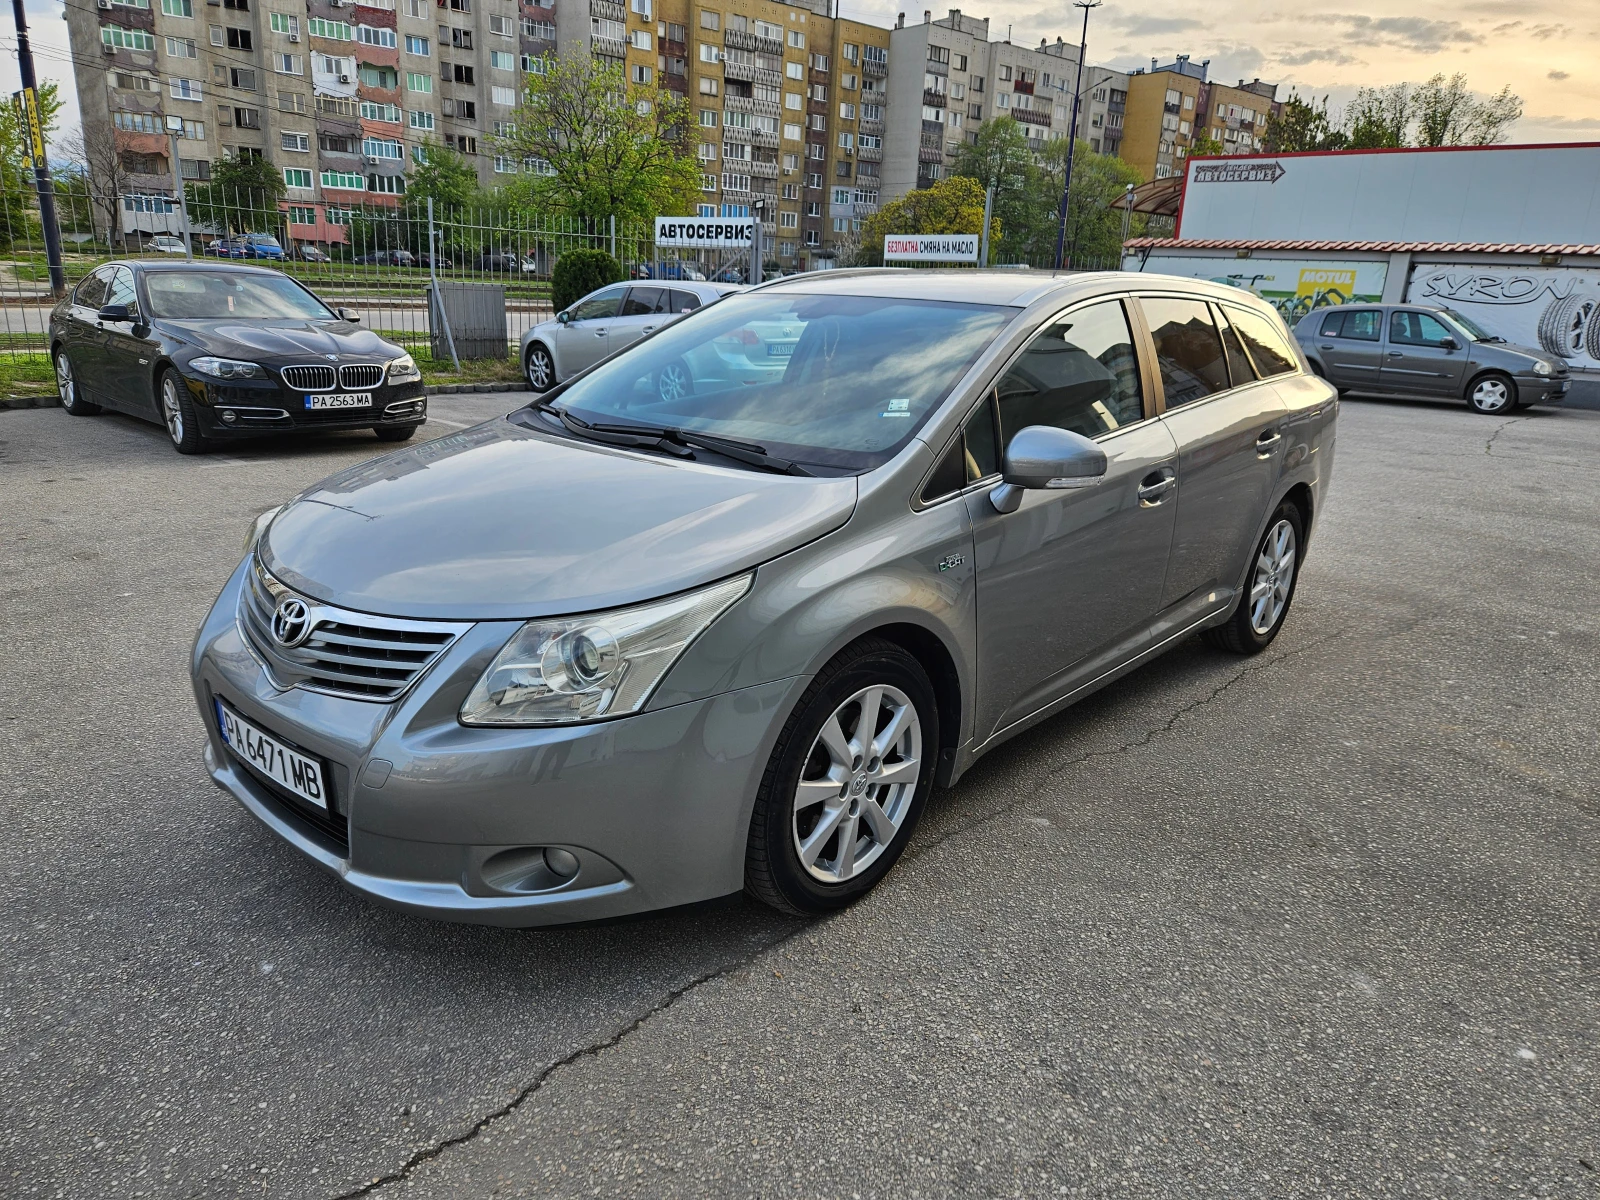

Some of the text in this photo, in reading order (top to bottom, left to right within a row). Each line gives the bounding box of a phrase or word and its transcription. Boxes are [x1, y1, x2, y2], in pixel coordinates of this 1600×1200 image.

[1197, 170, 1272, 182] АВТОСЕРВИЗ
[660, 224, 754, 240] АВТОСЕРВИЗ
[887, 241, 974, 254] БЕЗПЛАТНА СМЯНА НА МАСЛО
[1301, 270, 1353, 284] MOTUL
[1422, 273, 1577, 305] SYRON
[312, 396, 327, 407] PA
[329, 395, 355, 407] 2563
[356, 394, 370, 405] MA
[246, 728, 288, 783] 6471
[289, 754, 321, 800] MB
